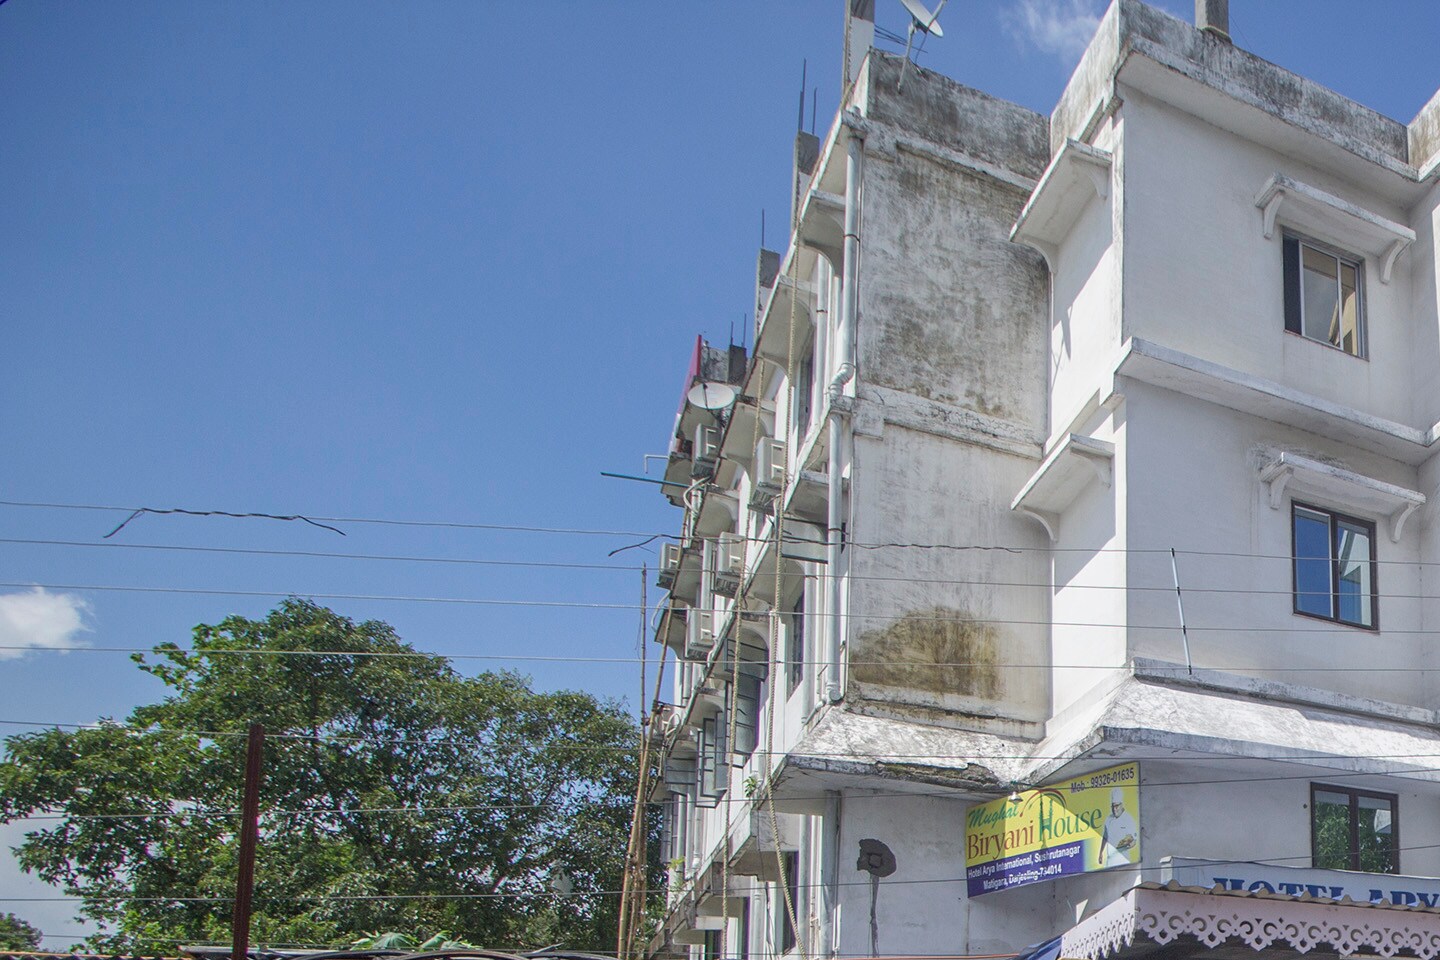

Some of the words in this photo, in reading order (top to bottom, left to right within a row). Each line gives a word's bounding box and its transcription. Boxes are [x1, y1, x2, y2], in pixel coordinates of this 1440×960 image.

[1090, 767, 1134, 788] 99326-01635
[968, 803, 1018, 829] Mughal
[967, 820, 1034, 860] Biryani
[1039, 797, 1102, 843] House
[967, 867, 982, 879] Hotel
[983, 865, 996, 876] Arya
